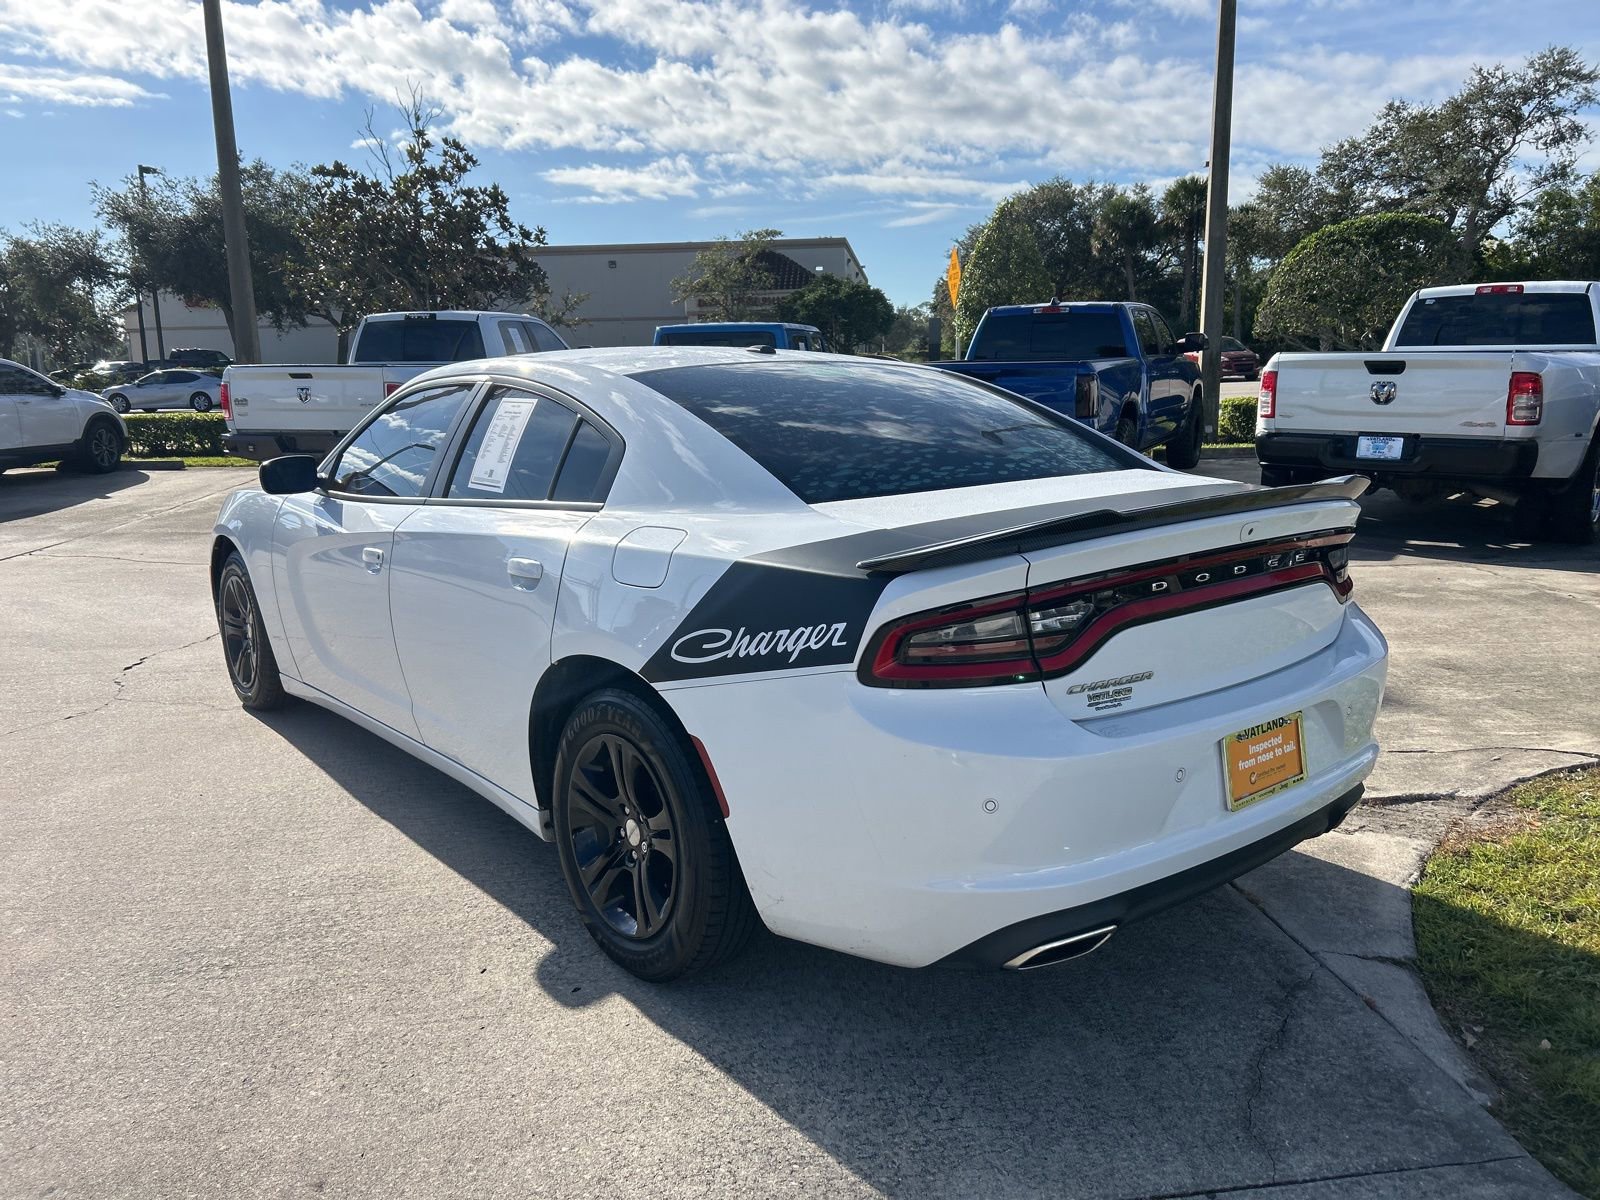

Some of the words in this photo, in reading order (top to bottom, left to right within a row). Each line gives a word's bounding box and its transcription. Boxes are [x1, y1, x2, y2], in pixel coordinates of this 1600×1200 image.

[1151, 550, 1305, 592] DODGE
[670, 622, 847, 664] Charger
[1066, 670, 1154, 695] CHARGER
[1087, 687, 1133, 702] VATLAND
[1243, 717, 1284, 740] VATLAND
[1248, 733, 1283, 755] Inspected
[1238, 757, 1256, 771] from
[1257, 751, 1274, 764] nose
[1274, 746, 1283, 756] to
